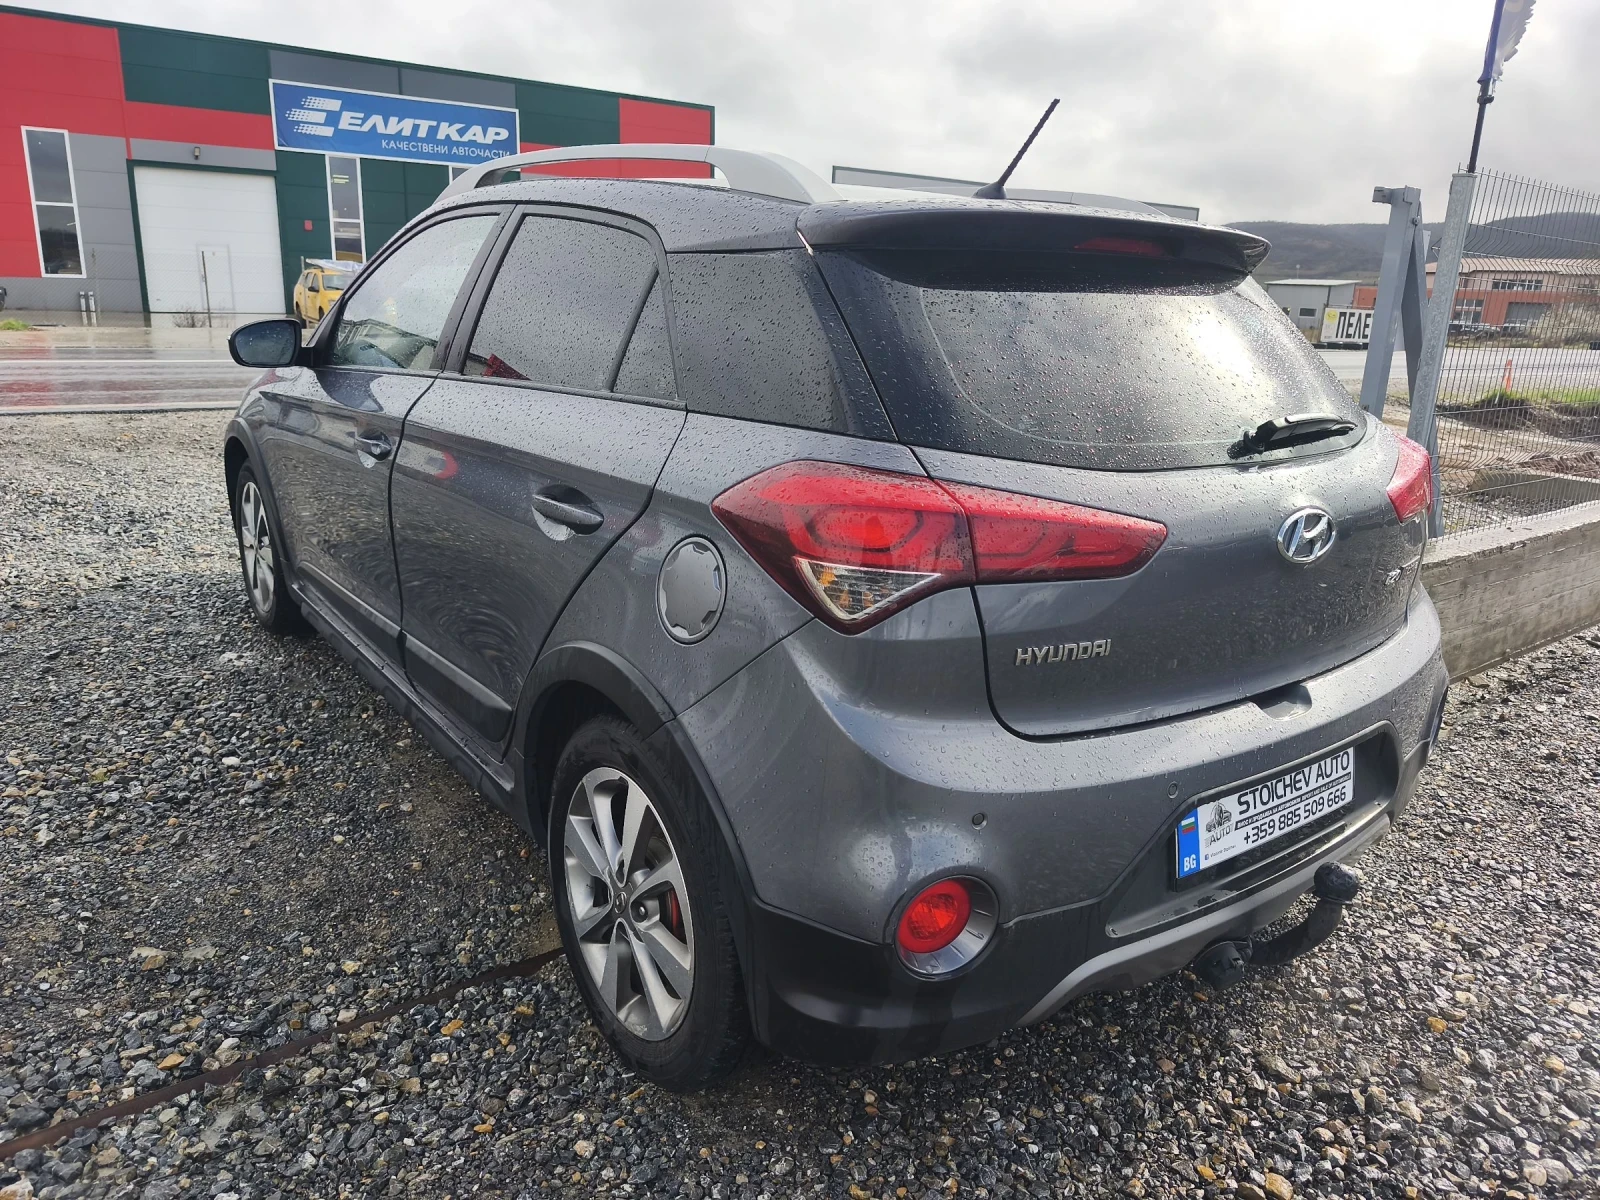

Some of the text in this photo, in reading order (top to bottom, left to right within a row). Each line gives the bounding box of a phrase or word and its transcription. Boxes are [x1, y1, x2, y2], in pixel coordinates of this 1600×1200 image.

[338, 111, 509, 144] ЕЛИТ КАР
[381, 139, 510, 159] КАЧЕСТВЕНИ АВТОЧАСТИ
[1015, 638, 1112, 666] HYUNDAI
[1237, 765, 1312, 816] STOICHEV
[1315, 750, 1350, 784] AUTO
[1243, 818, 1276, 845] +359
[1278, 806, 1301, 832] 885
[1303, 796, 1325, 820] 509
[1327, 785, 1346, 808] 666
[1183, 853, 1197, 872] BG
